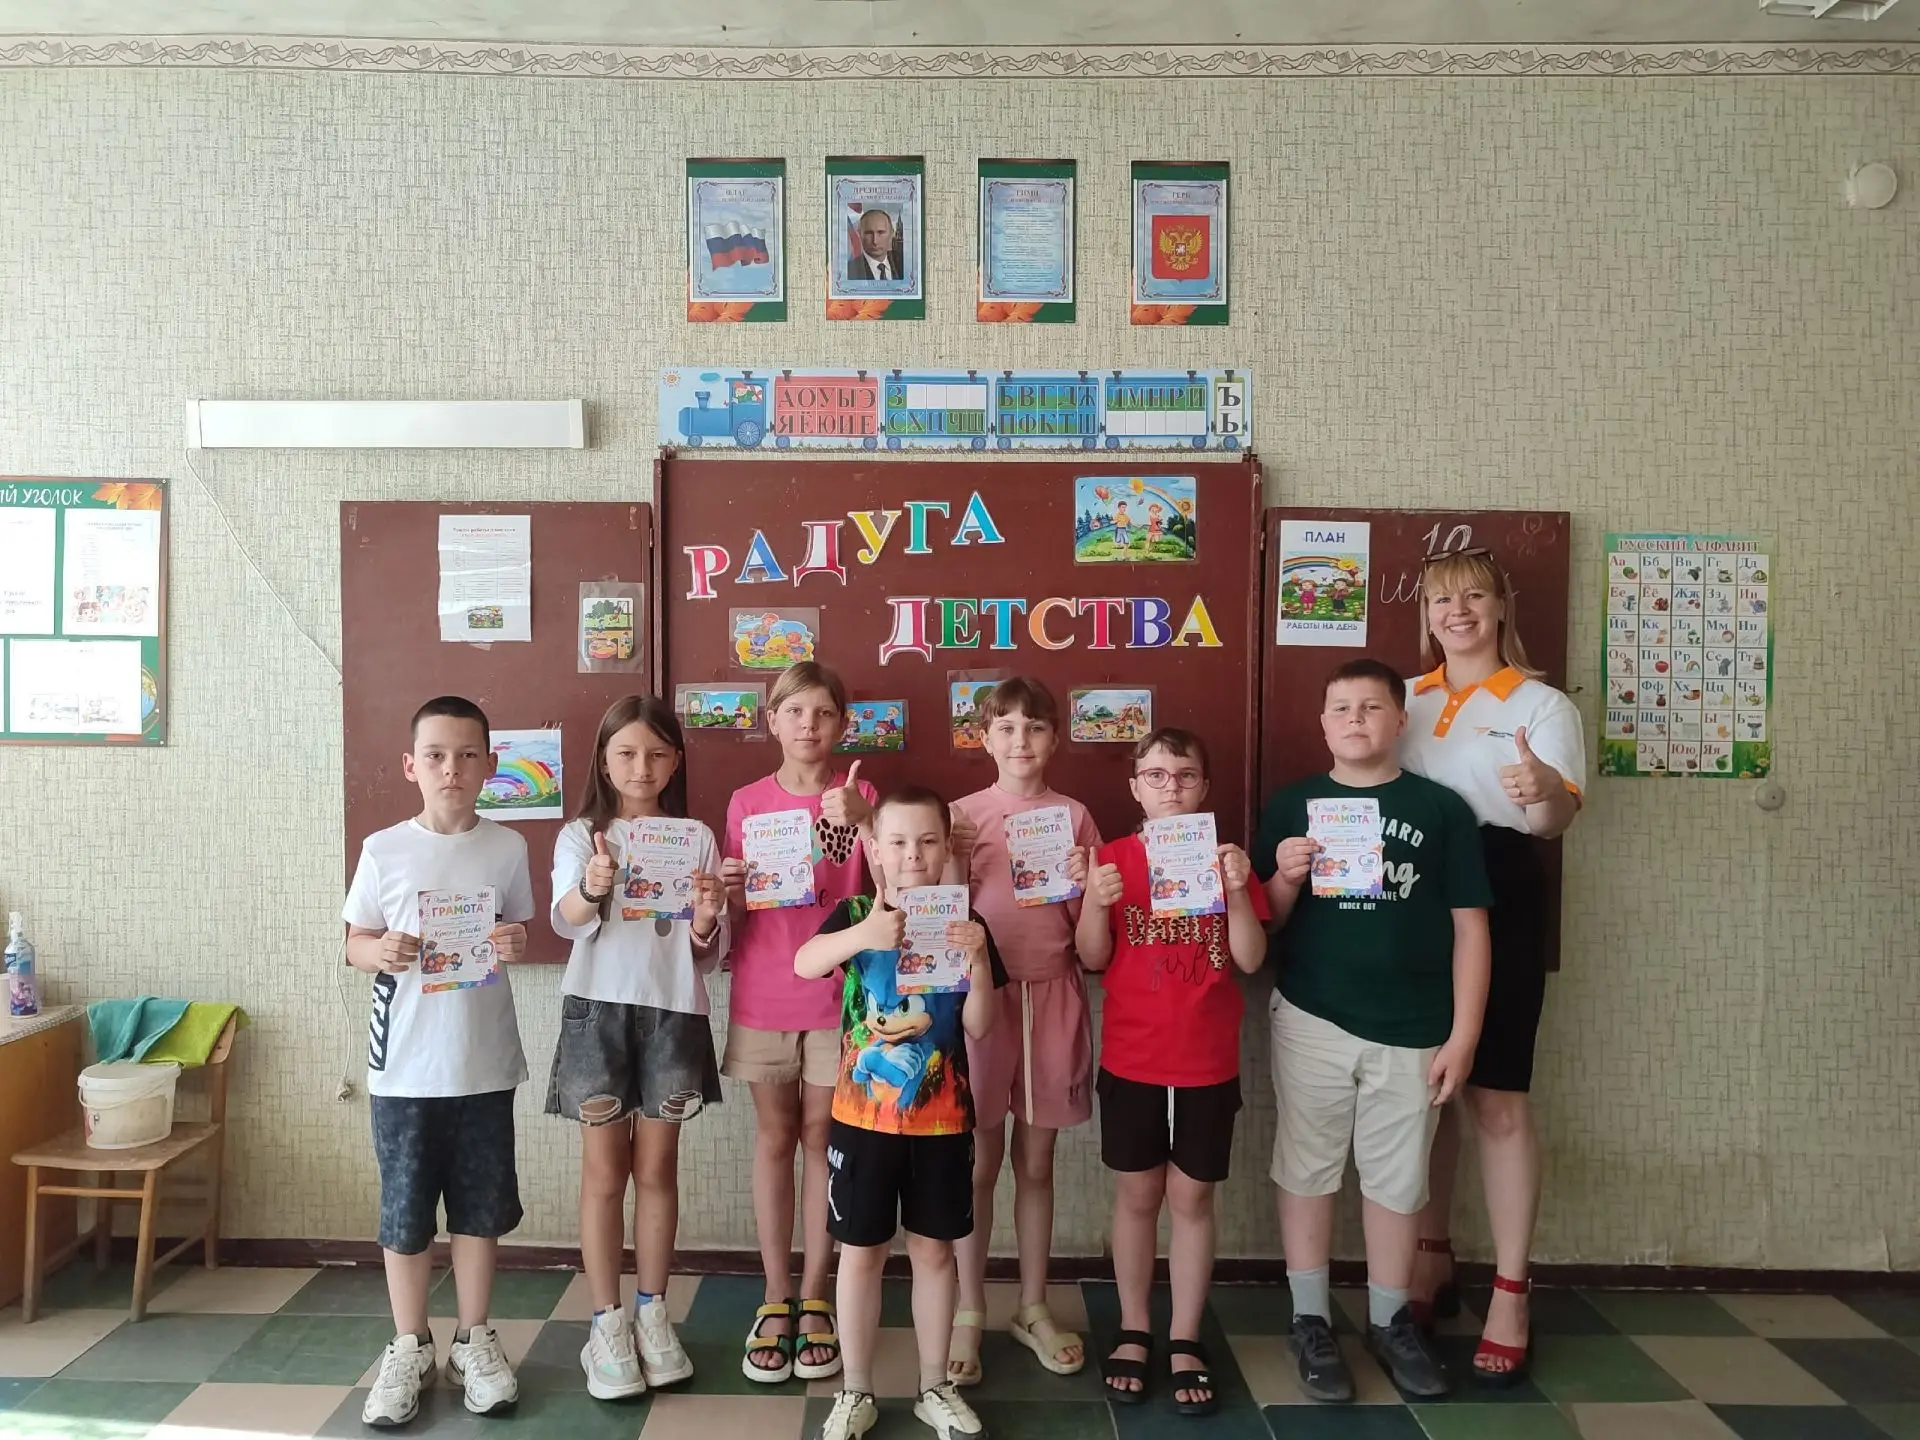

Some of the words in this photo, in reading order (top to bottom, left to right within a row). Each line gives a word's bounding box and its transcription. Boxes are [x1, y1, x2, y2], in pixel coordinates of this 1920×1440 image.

[22, 488, 83, 505] УГОЛОК
[1305, 531, 1345, 543] ПЛАН
[683, 490, 1005, 600] РАДУГА
[1619, 537, 1686, 551] РУССКИЙ
[1694, 540, 1760, 552] АЛФАВИТ
[879, 595, 1223, 667] ДЕТСТВА
[1286, 622, 1319, 630] РАБОТЫ
[1322, 622, 1334, 630] НА
[1336, 622, 1358, 631] ДЕНЬ
[1320, 814, 1369, 825] ГРАМОТА
[754, 826, 800, 839] ГРАМОТА
[1017, 823, 1062, 838] ГРАМОТА
[642, 834, 690, 847] ГРАМОТА
[1157, 831, 1205, 845] ГРАМОТА
[432, 904, 484, 917] ГРАМОТА
[909, 904, 958, 916] ГРАМОТА
[1339, 902, 1361, 910] KNOCK
[1363, 902, 1377, 911] OUT
